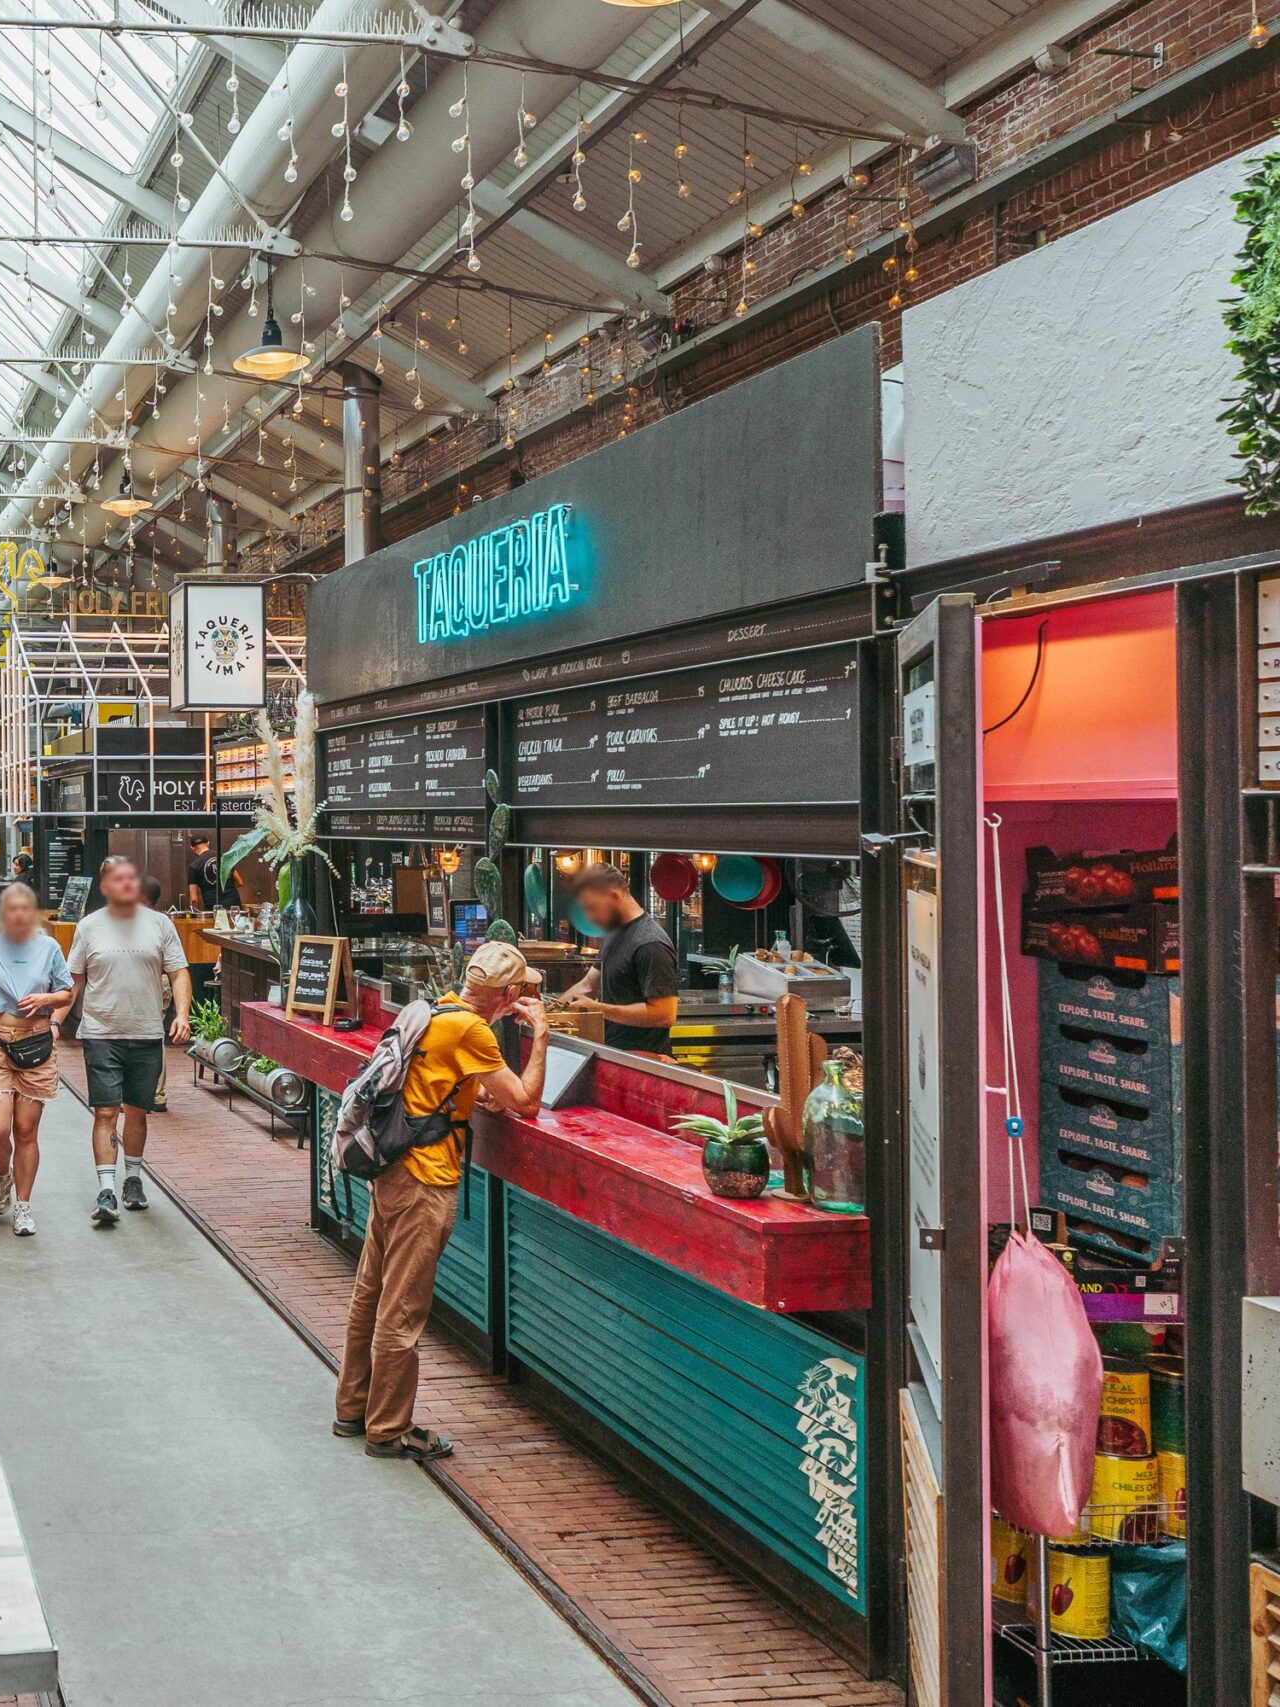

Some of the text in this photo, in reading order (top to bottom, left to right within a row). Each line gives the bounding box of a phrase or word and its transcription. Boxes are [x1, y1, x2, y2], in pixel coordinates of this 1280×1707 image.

[413, 503, 571, 643] TAQUERIA
[62, 590, 123, 615] HOLY
[195, 616, 255, 649] TAQUERIA
[727, 623, 767, 642] DESSERT
[205, 660, 246, 676] LIMA
[719, 675, 753, 693] CHURROS
[756, 671, 785, 690] CHEESE
[607, 694, 623, 708] BEEF
[625, 689, 659, 706] BARBACOA
[718, 717, 736, 729] SPICE
[761, 713, 776, 727] HOT
[606, 730, 625, 746] PORK
[625, 727, 658, 745] CARNITAS
[518, 740, 542, 756] CHICKEN
[606, 769, 626, 782] POLLO
[153, 780, 195, 796] HOLY
[173, 800, 200, 812] EST.
[1058, 1003, 1148, 1029] EXPLORE. TASTE. SHARE.
[1059, 1064, 1149, 1094] EXPLORE. TASTE. SHARE.
[1059, 1129, 1151, 1160] EXPLORE. TASTE. SHARE.
[1057, 1192, 1150, 1228] EXPLORE. TASTE. SHARE.
